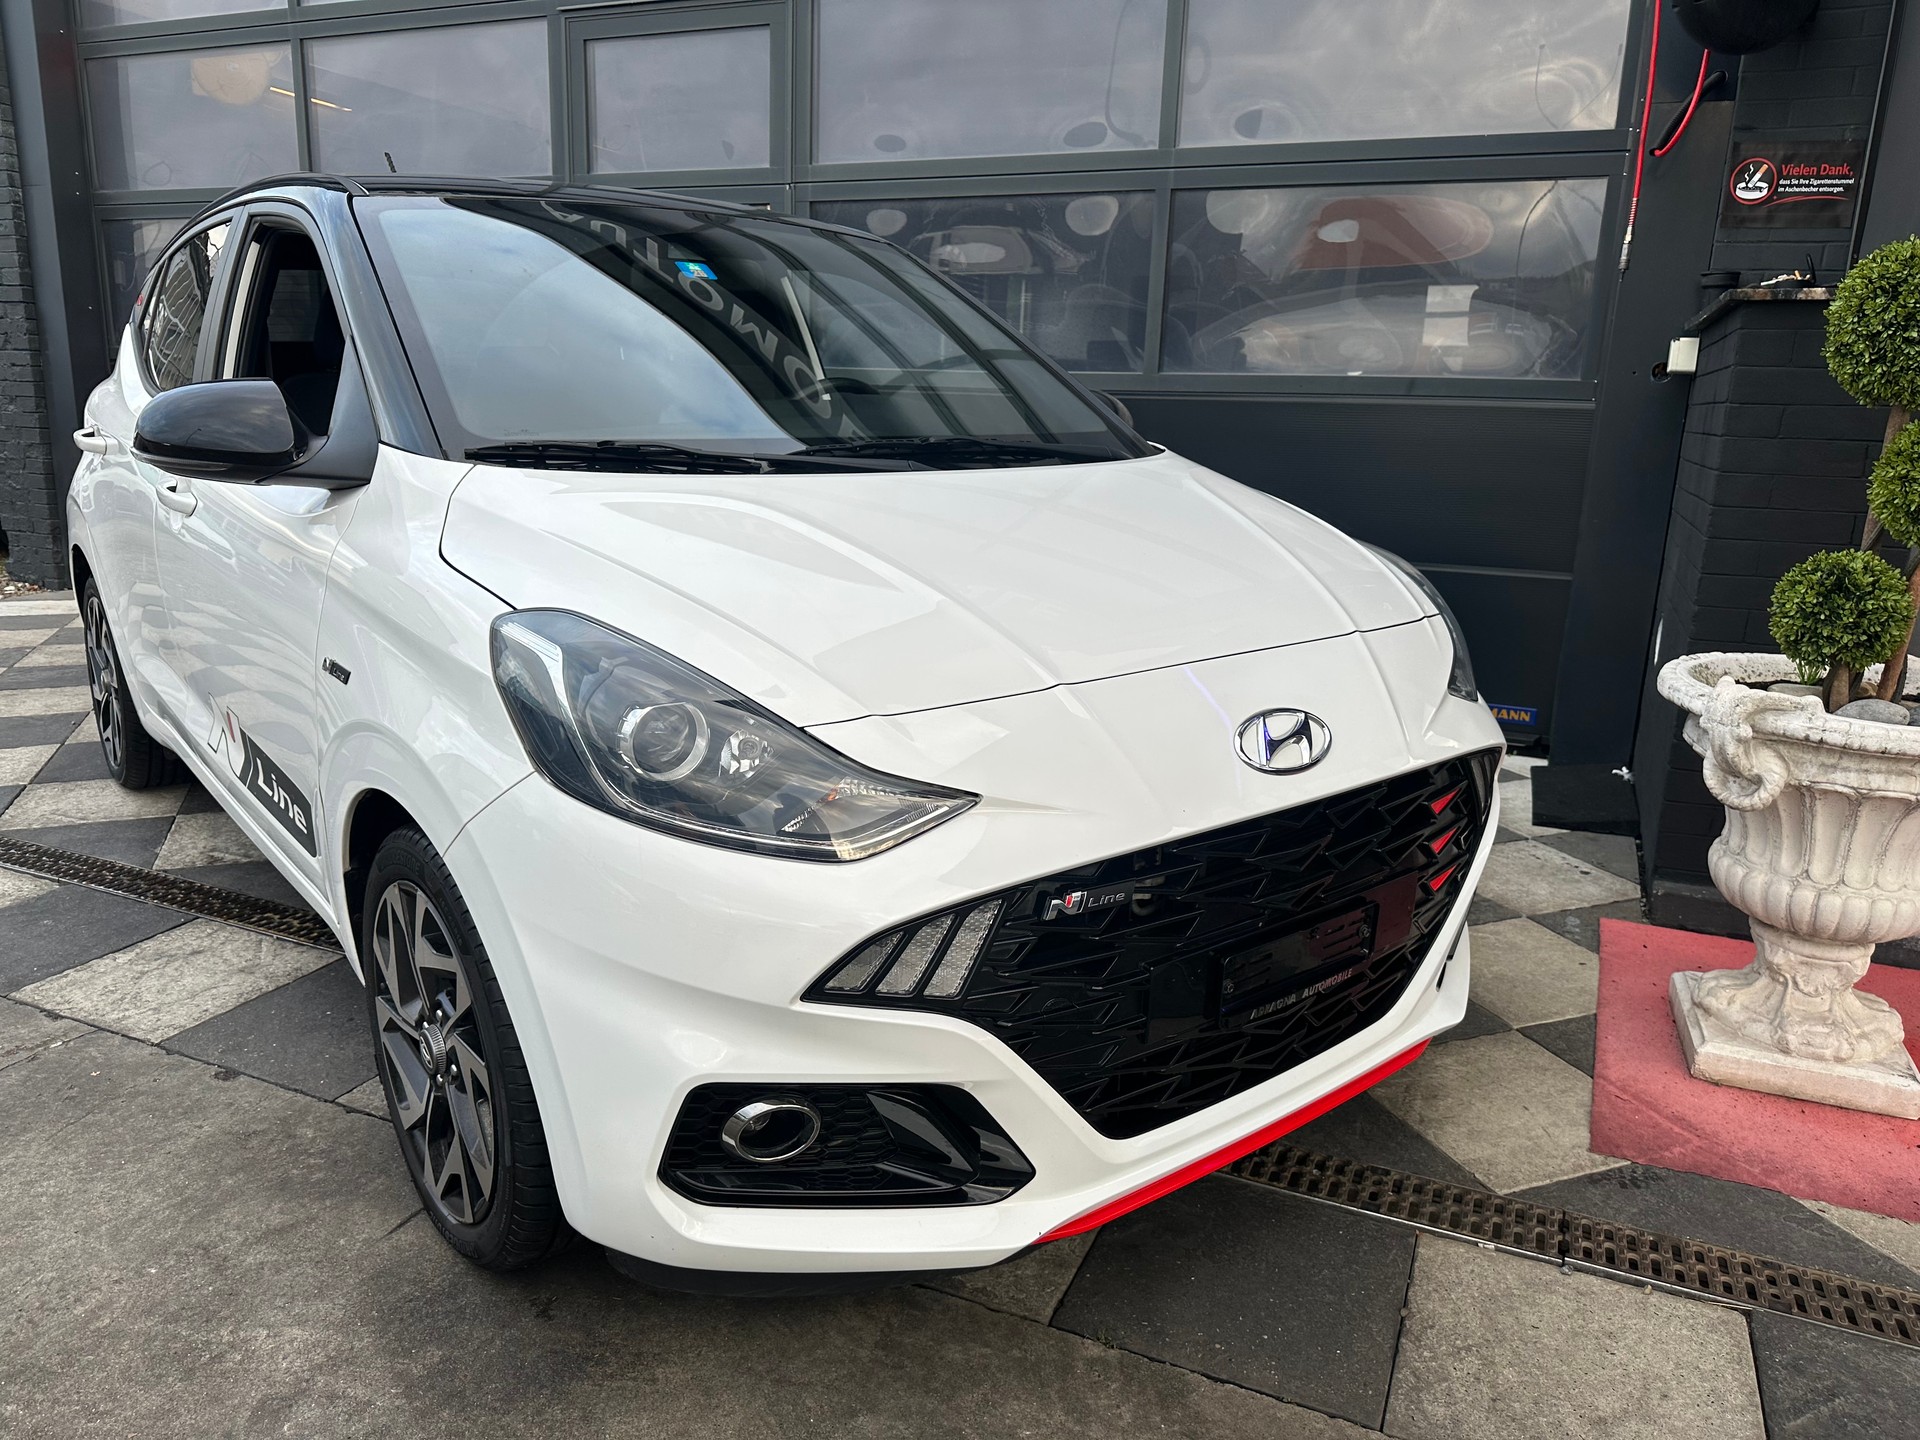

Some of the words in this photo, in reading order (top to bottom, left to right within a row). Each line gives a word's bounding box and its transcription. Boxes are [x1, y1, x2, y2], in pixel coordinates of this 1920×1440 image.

[1781, 164, 1817, 175] Vielen
[1820, 163, 1853, 177] Dank,
[1810, 178, 1855, 186] Zigarettenstummel
[256, 757, 308, 834] Line
[1087, 892, 1125, 908] Line
[1301, 968, 1353, 999] AUTOMOBILE
